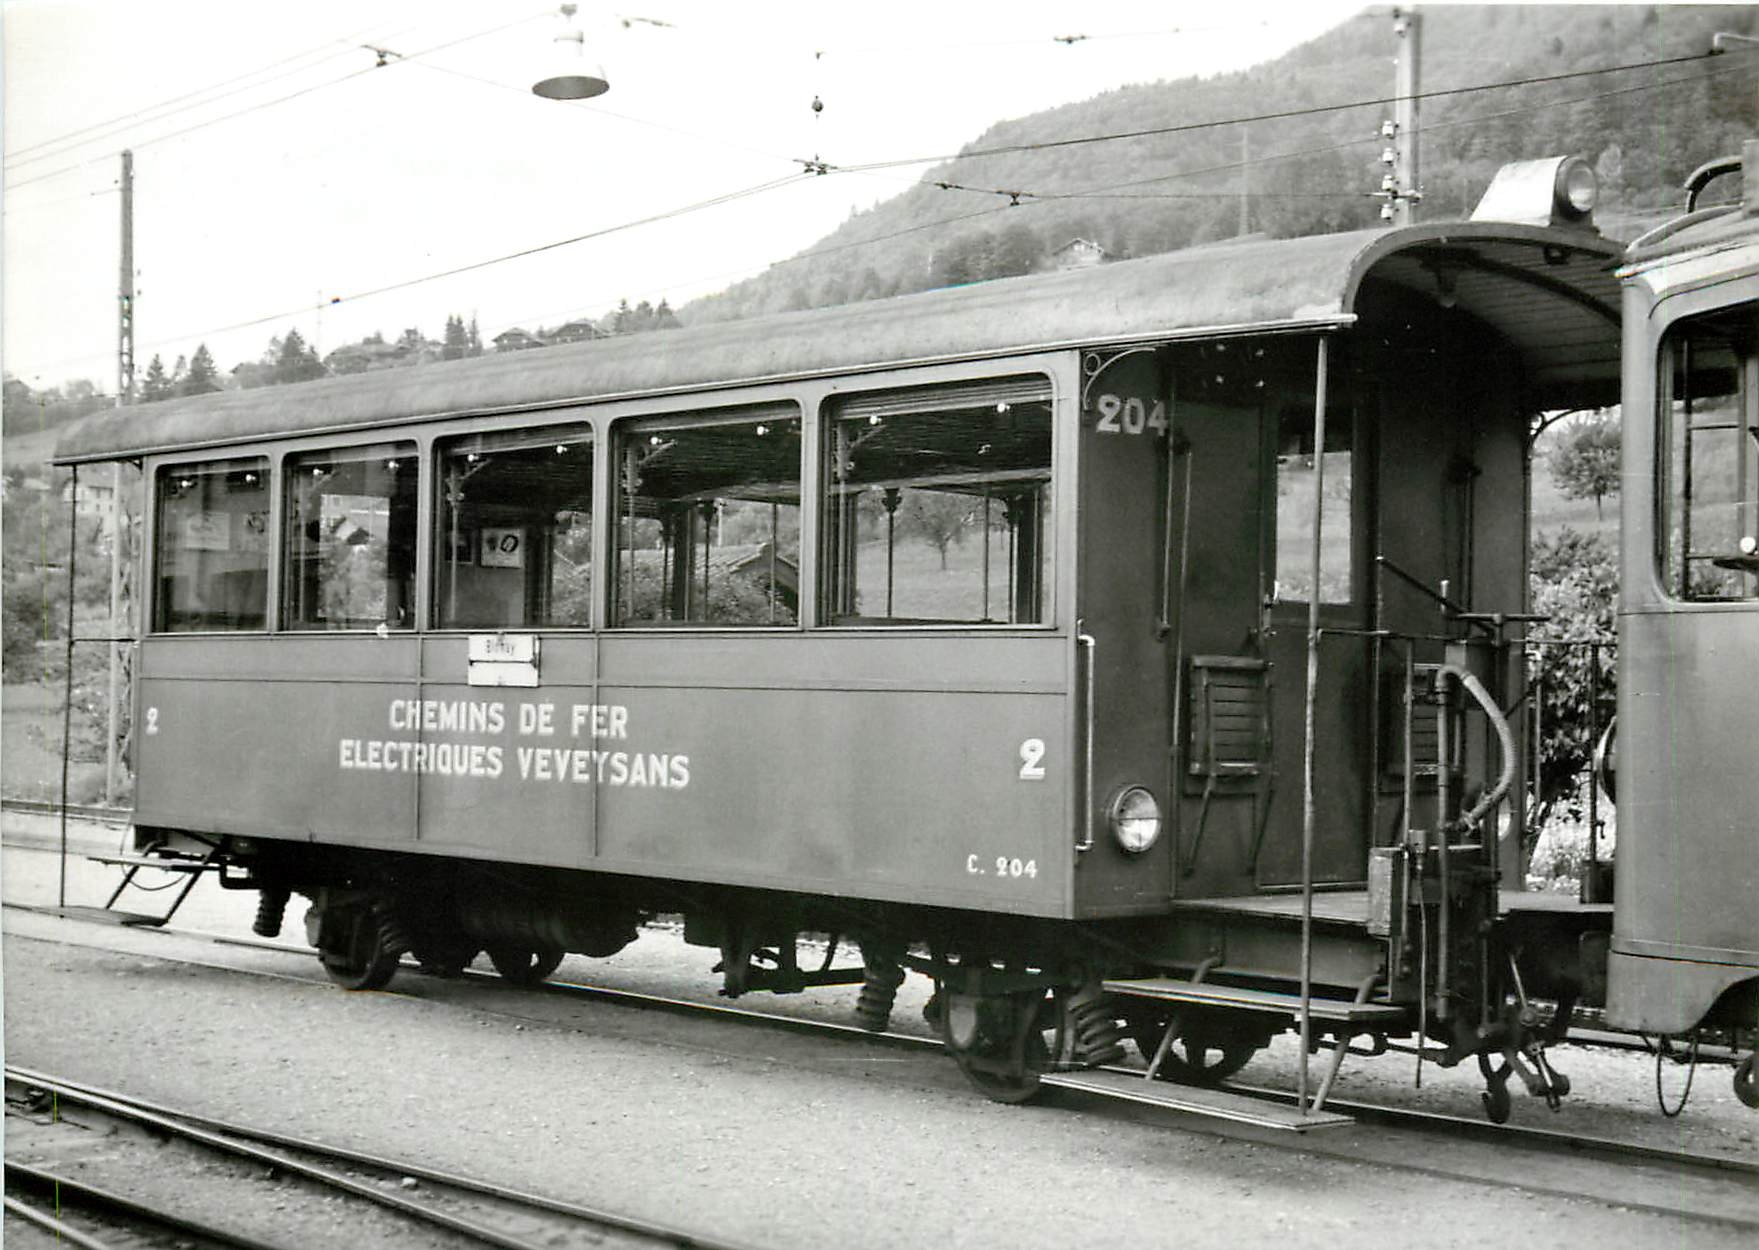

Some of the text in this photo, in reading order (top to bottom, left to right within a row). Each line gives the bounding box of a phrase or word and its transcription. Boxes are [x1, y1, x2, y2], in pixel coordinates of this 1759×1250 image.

[1096, 394, 1168, 436] 204
[146, 707, 159, 735] 2
[389, 699, 628, 739] CHEMINS DE FER
[339, 738, 691, 789] ELECTRIQUES VEVEYSANS
[1019, 738, 1046, 780] 2
[967, 854, 1038, 878] C. 204
